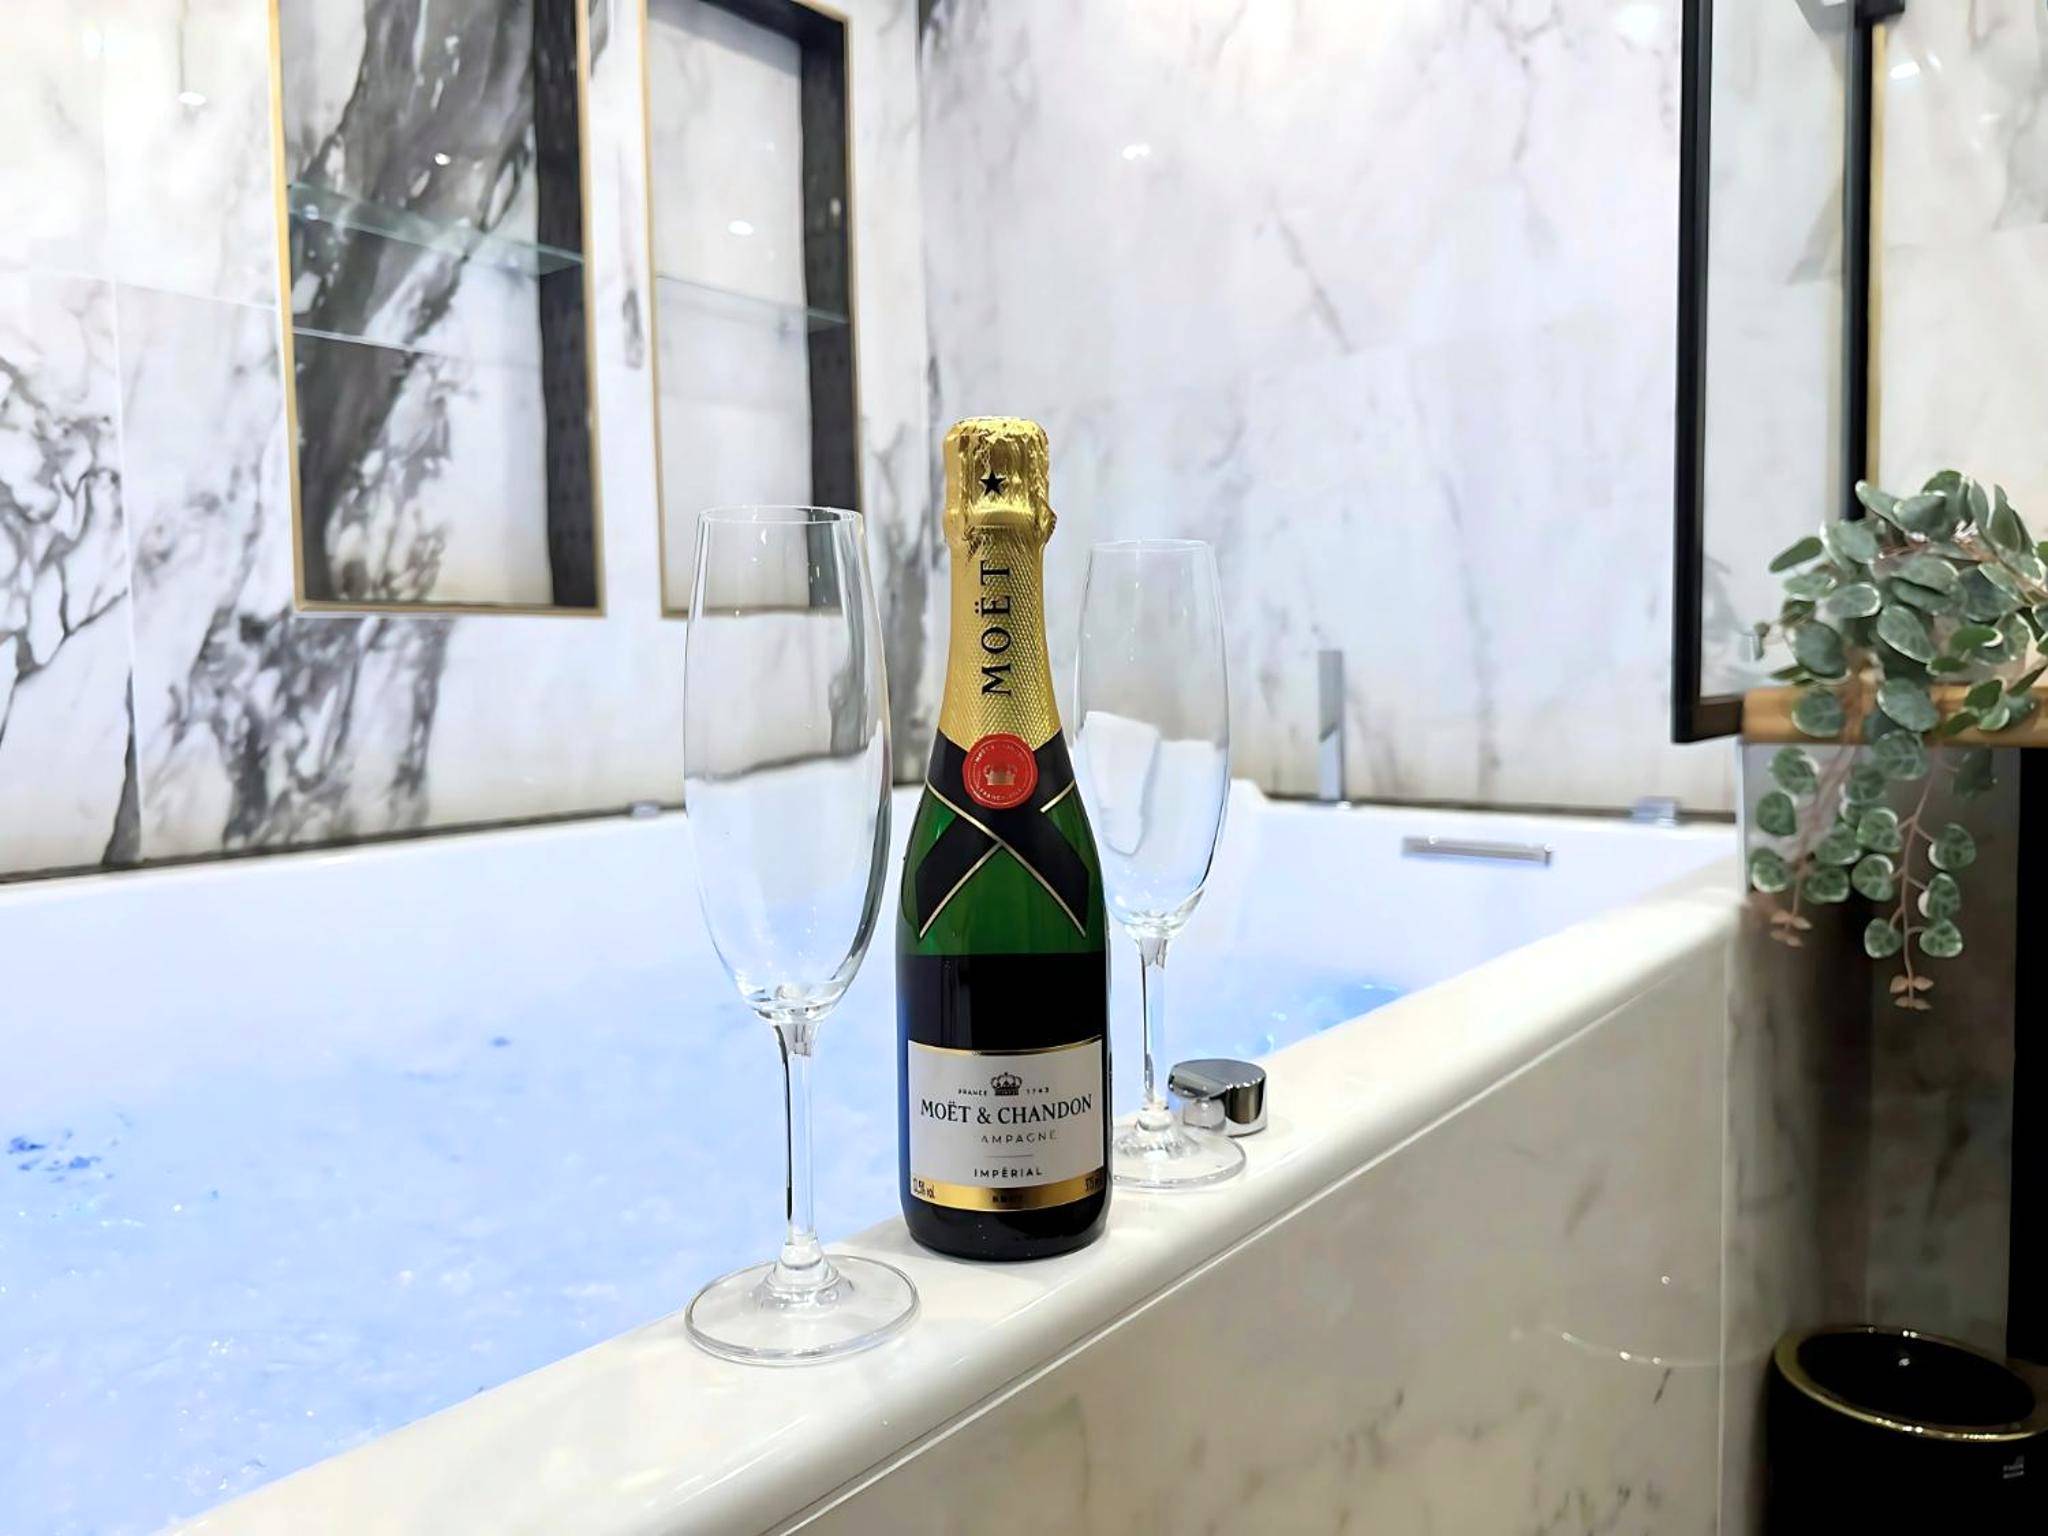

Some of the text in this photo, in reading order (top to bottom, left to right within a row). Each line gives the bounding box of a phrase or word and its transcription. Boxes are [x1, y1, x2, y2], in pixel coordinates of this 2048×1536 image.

[975, 559, 1012, 697] MOËT
[920, 1093, 1093, 1125] MOËT & CHANDON
[979, 1129, 1058, 1144] AMPAGNE
[973, 1166, 1043, 1179] IMPÉRIAL
